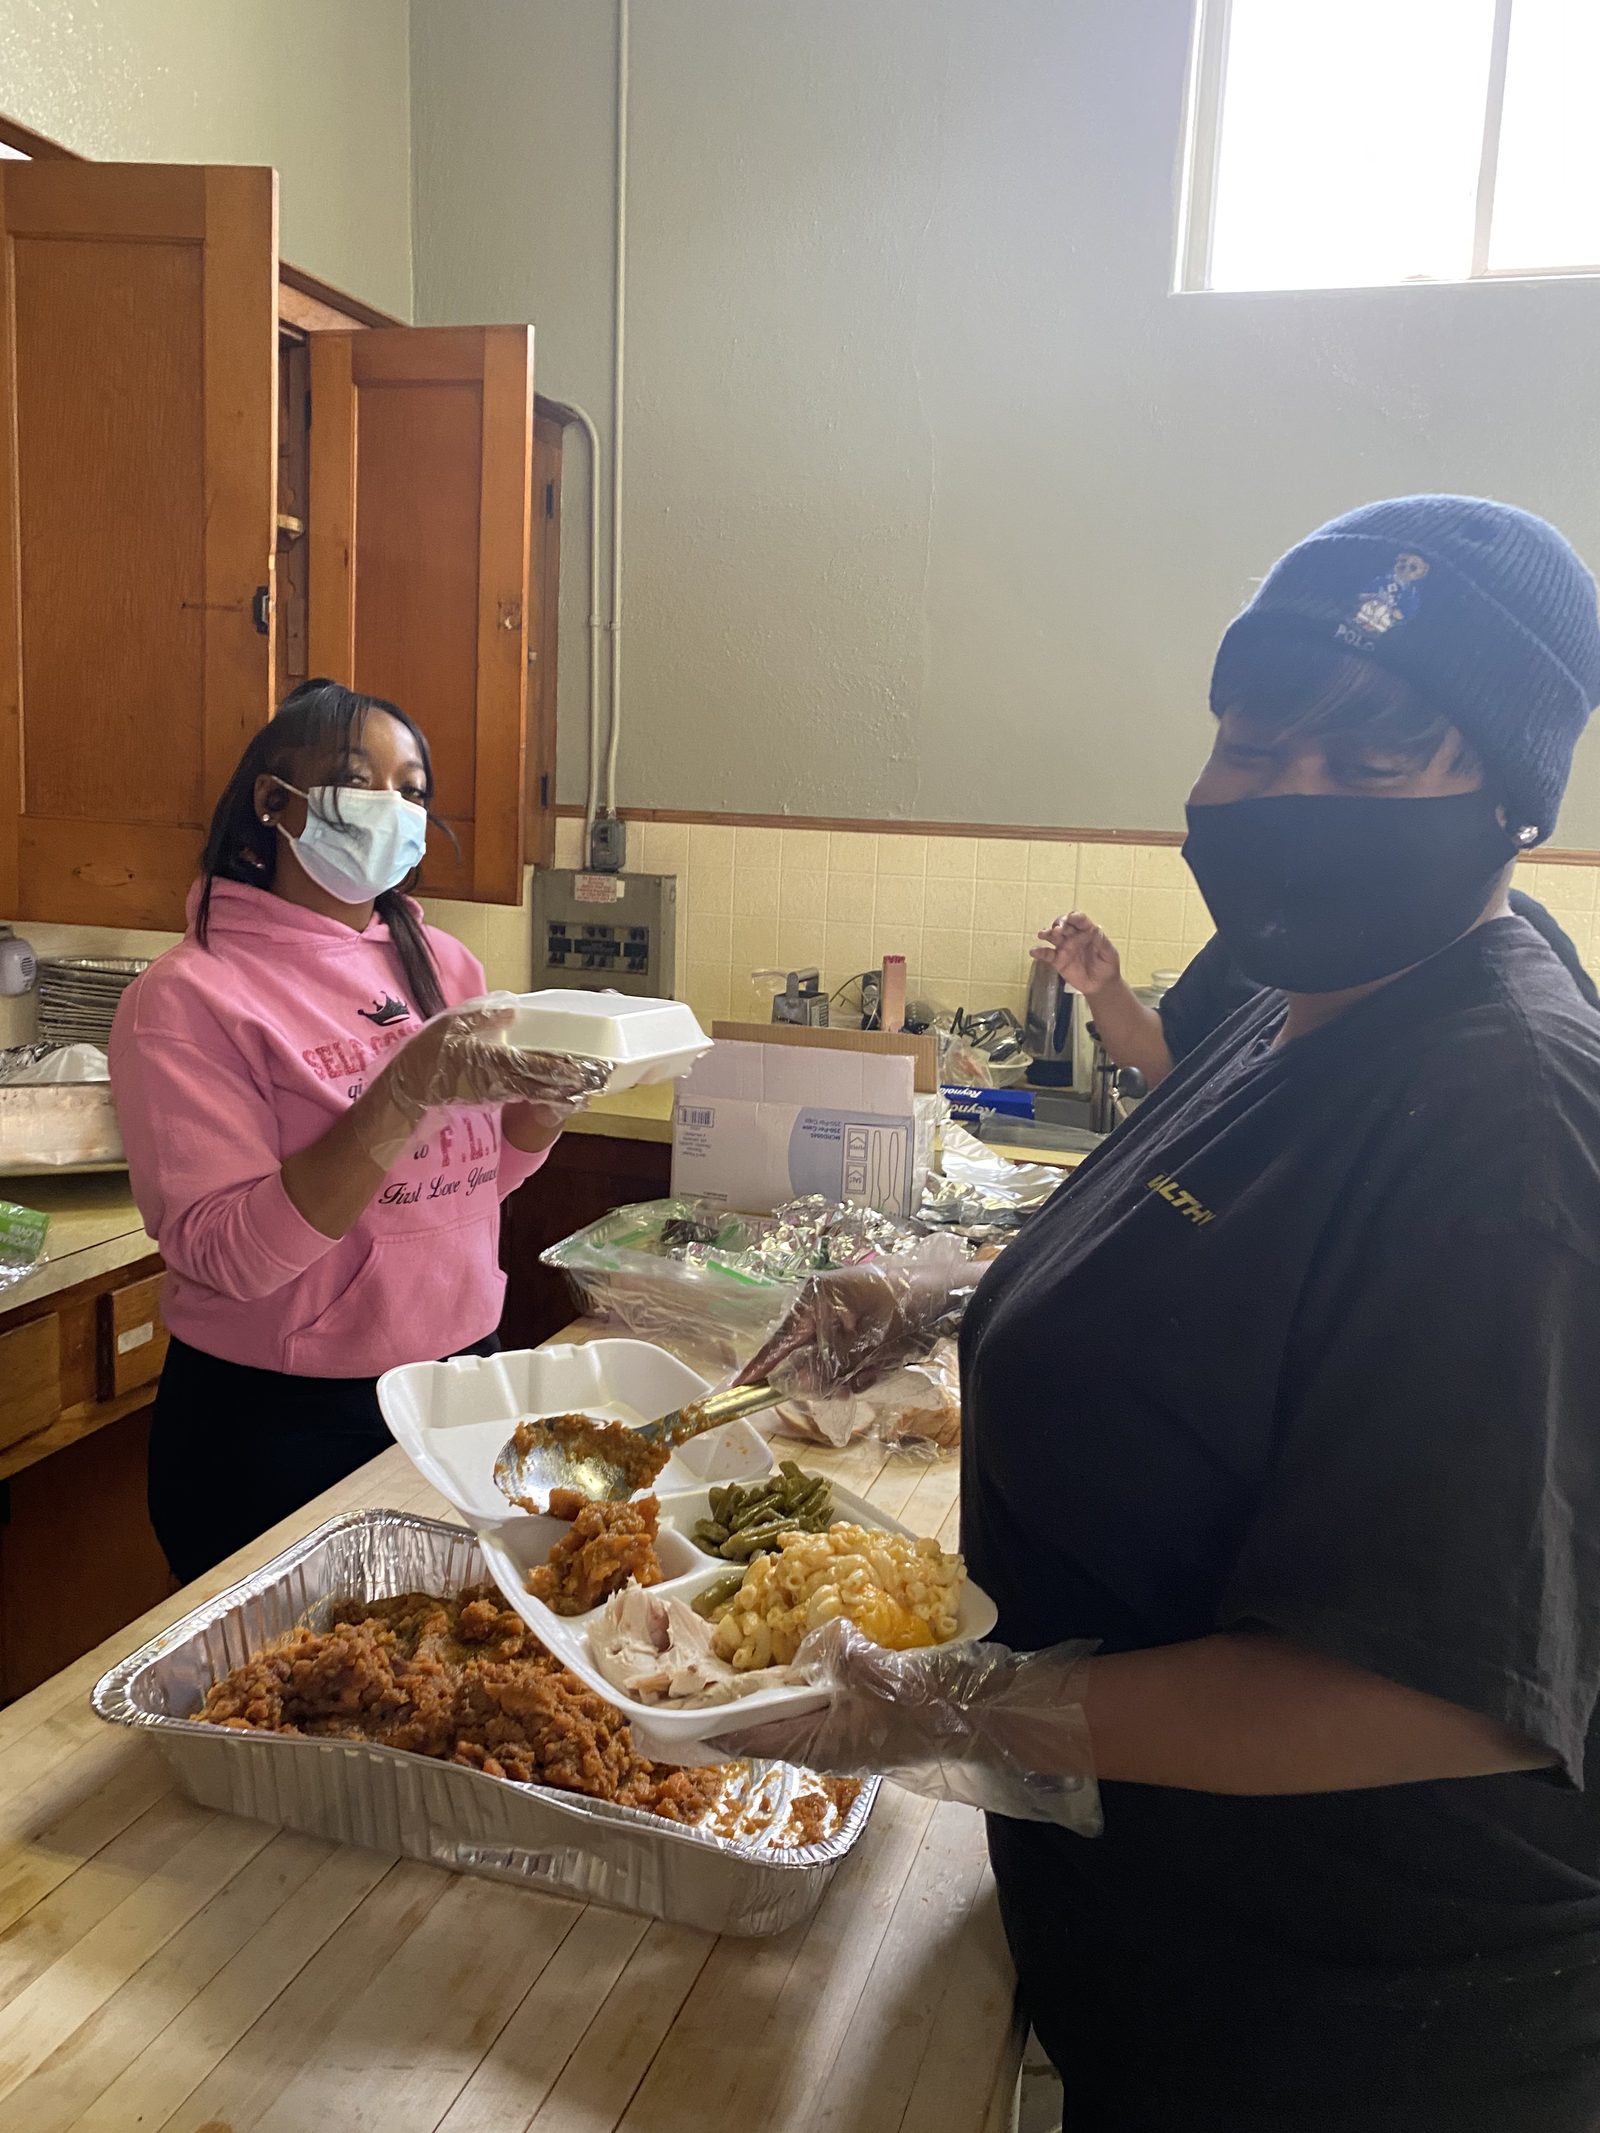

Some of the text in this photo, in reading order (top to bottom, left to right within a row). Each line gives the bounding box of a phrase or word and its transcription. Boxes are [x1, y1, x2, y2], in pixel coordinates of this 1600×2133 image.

[1334, 623, 1375, 651] POLO
[378, 1182, 421, 1206] First
[427, 1175, 460, 1200] Love
